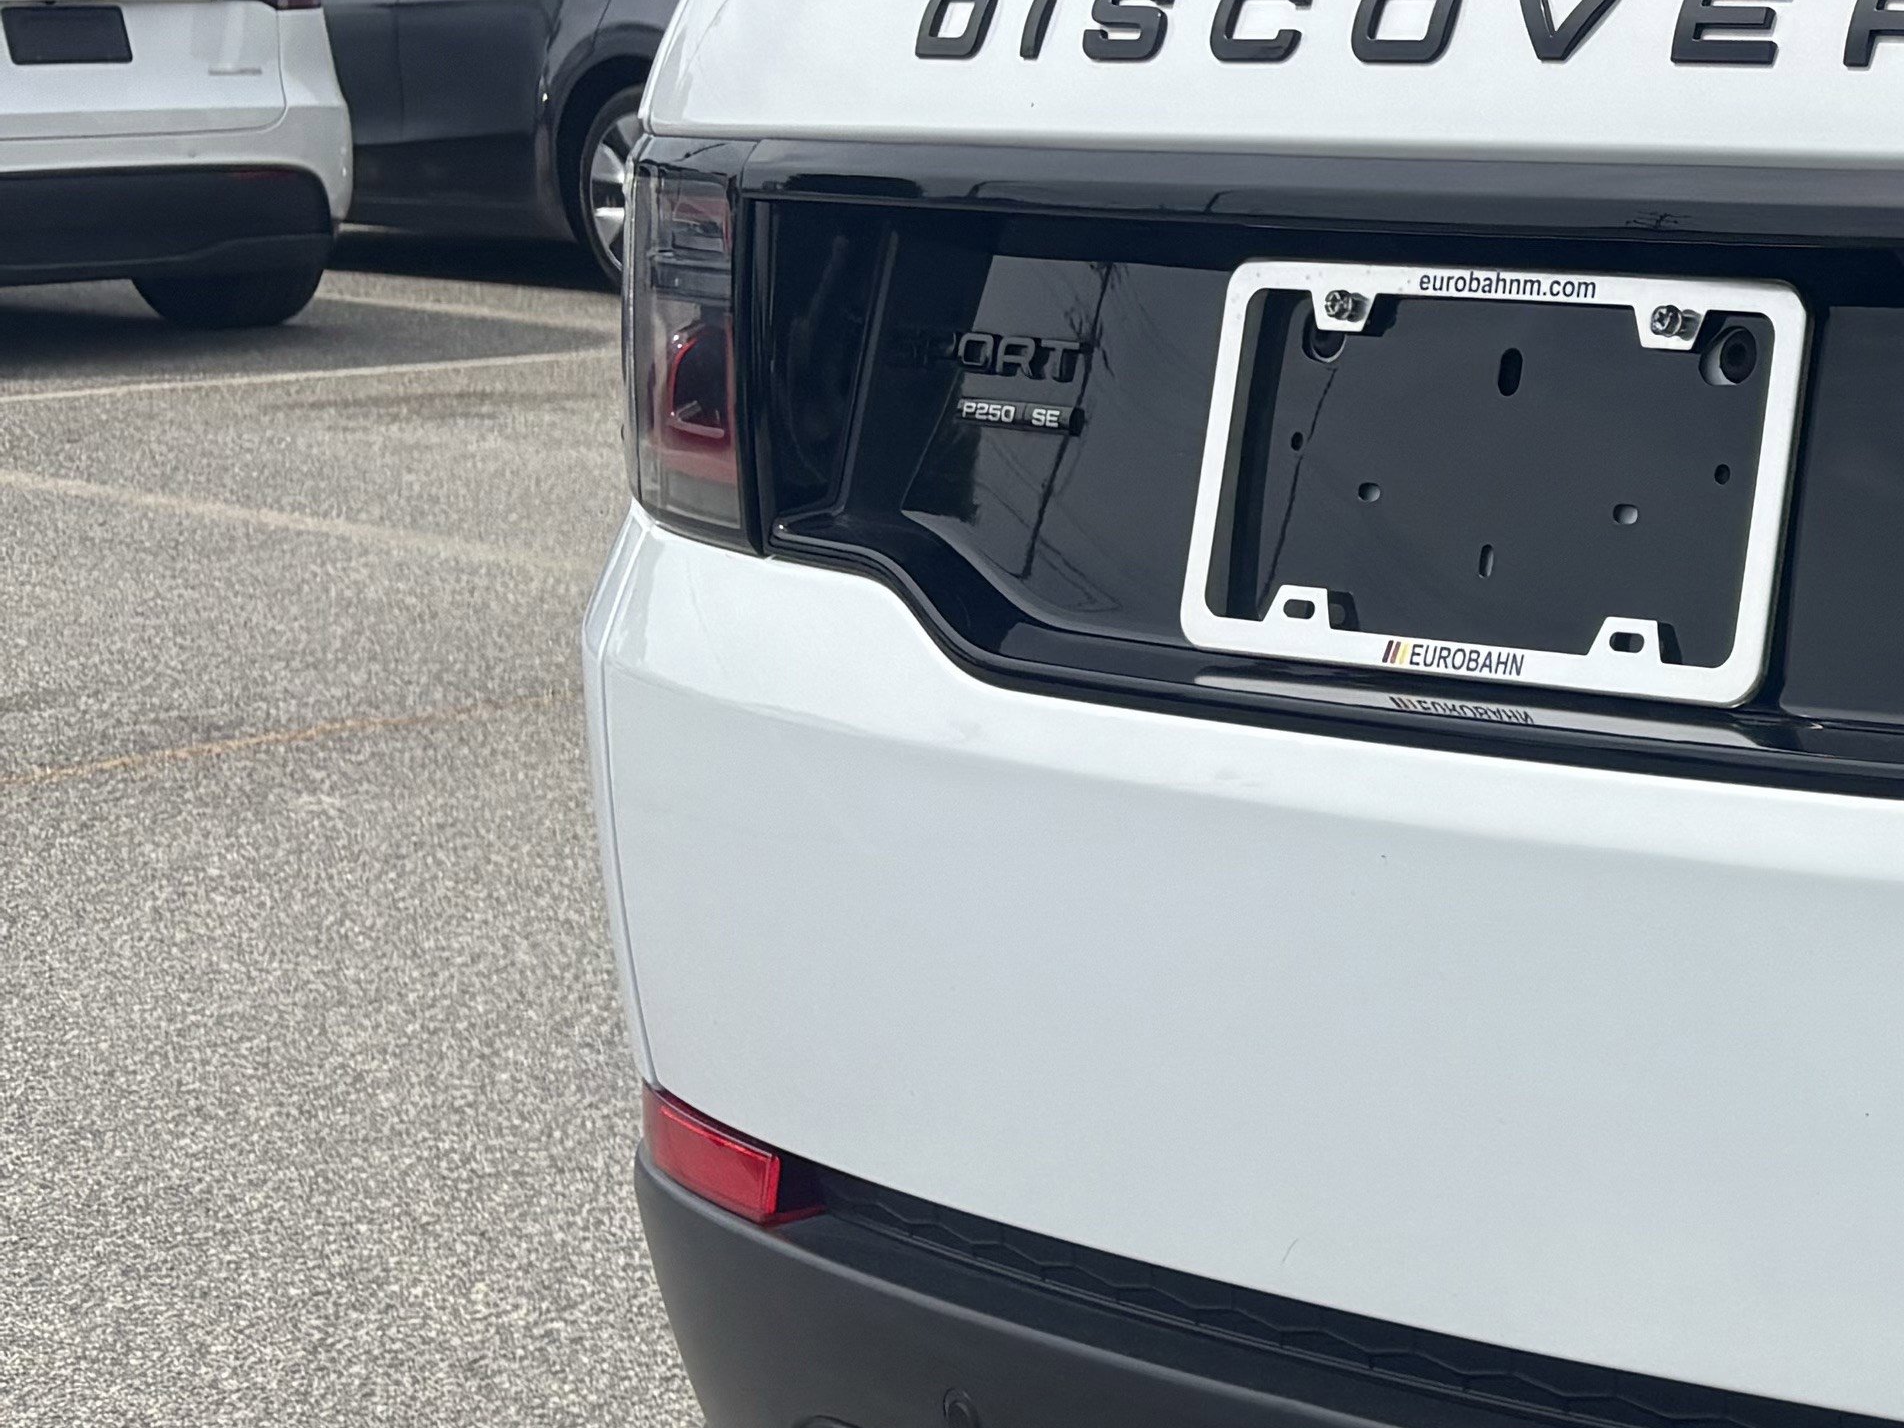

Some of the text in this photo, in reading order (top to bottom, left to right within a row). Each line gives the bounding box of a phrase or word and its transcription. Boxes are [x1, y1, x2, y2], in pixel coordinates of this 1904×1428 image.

[1419, 270, 1597, 299] eurobahnm.com
[961, 401, 1061, 429] P250 SE
[1409, 644, 1525, 676] EUROBAHN
